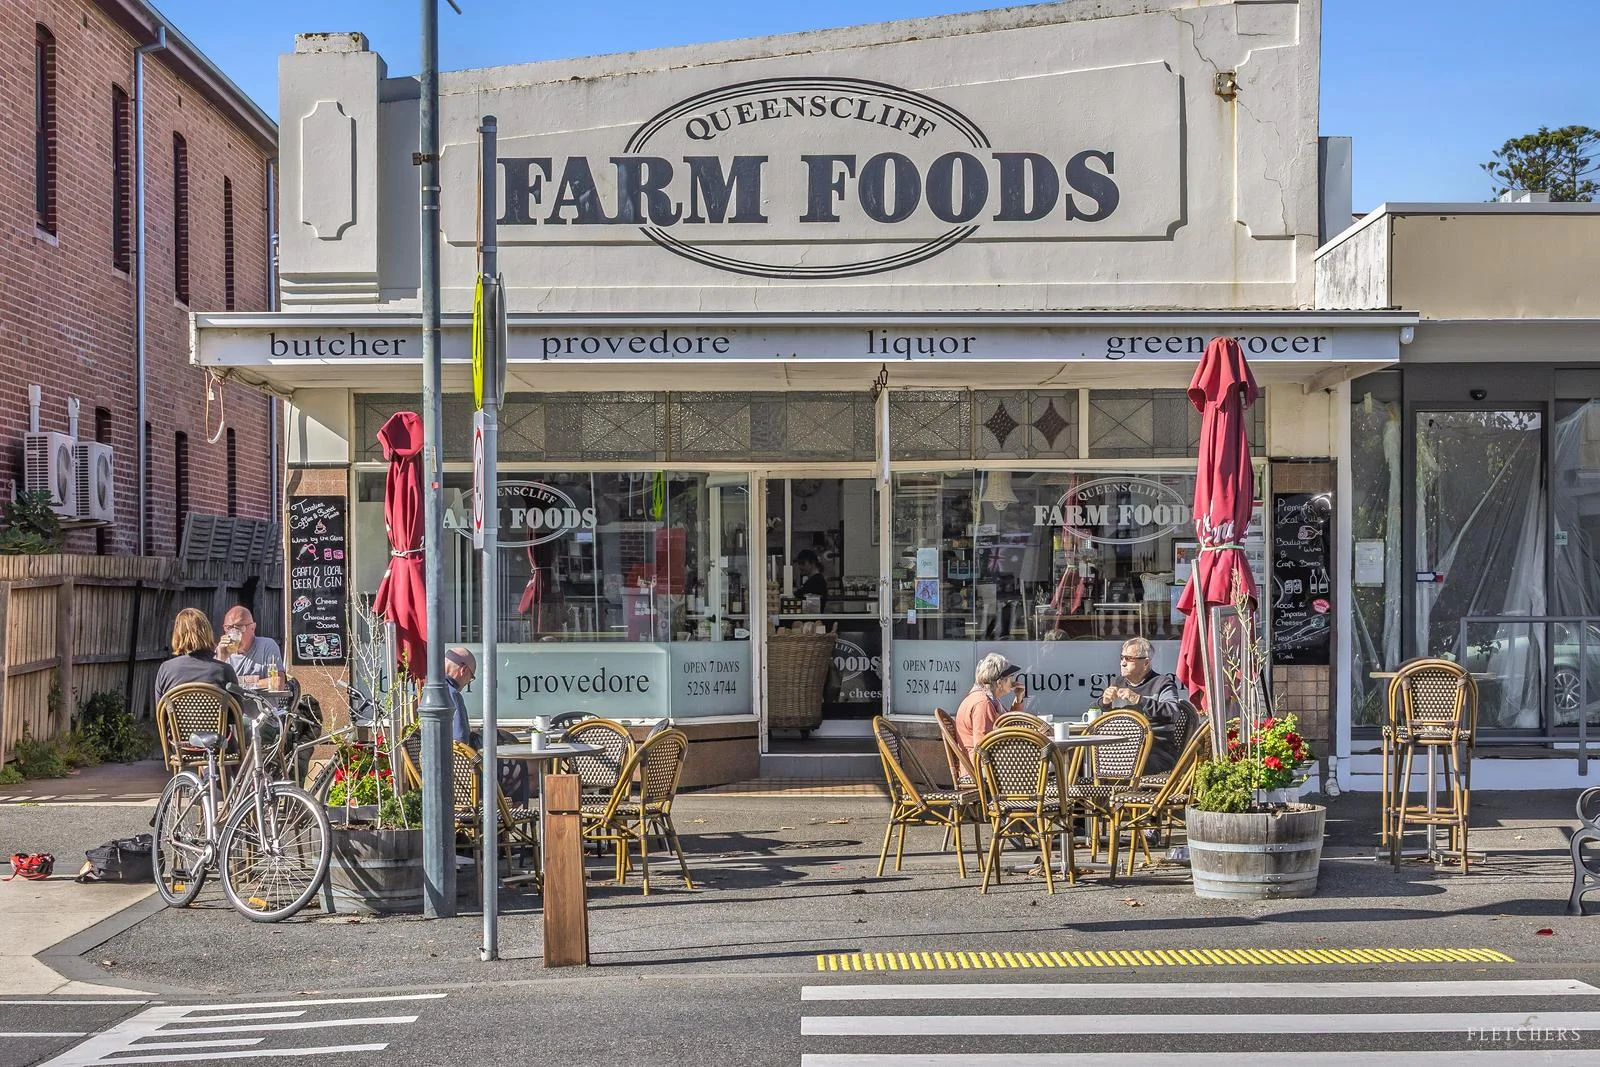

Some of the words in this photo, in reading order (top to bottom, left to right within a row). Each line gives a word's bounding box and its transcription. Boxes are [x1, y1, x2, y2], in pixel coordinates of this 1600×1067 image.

[685, 95, 937, 141] QUEENSCLIFF
[496, 155, 768, 227] FARM
[799, 150, 1120, 224] FOODS
[269, 332, 406, 357] butcher
[541, 330, 730, 360] provedore
[867, 330, 976, 360] liquor
[1106, 335, 1327, 360] greenrocer
[497, 486, 558, 504] ENSCLIFF
[1077, 483, 1166, 501] QUEENSCLIFF
[510, 507, 598, 529] FOODS
[1033, 504, 1110, 526] FARM
[1117, 504, 1191, 526] FOOD
[291, 566, 312, 577] CRAFT
[323, 565, 343, 576] LOCAL
[292, 578, 312, 590] BEER
[323, 576, 342, 588] GIN
[683, 661, 707, 674] OPEN
[709, 661, 715, 673] 7
[716, 661, 740, 673] DAYS
[833, 655, 882, 672] OODS
[902, 659, 927, 672] OPEN
[929, 659, 935, 671] 7
[936, 660, 961, 673] DAYS
[516, 667, 650, 700] provedore
[686, 681, 710, 696] 5258
[711, 680, 737, 695] 4744
[906, 679, 929, 694] 5258
[932, 679, 957, 694] 4744
[849, 688, 882, 699] chees
